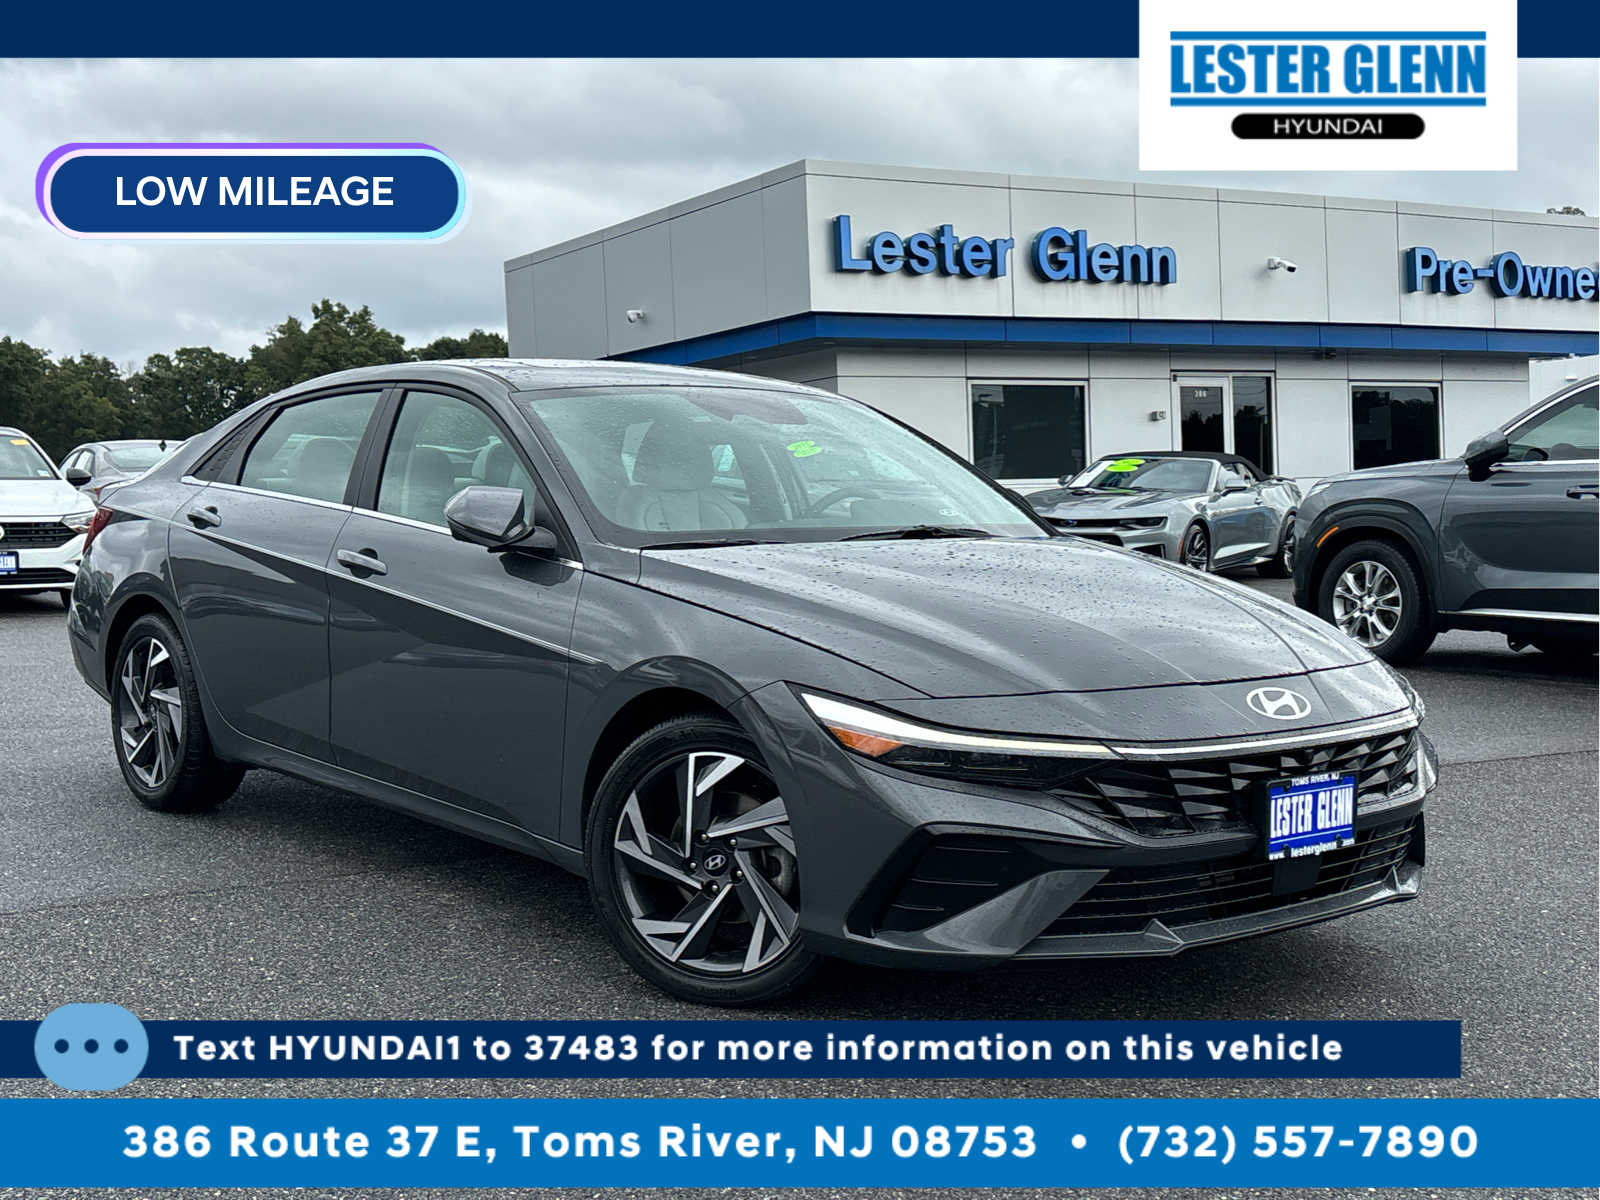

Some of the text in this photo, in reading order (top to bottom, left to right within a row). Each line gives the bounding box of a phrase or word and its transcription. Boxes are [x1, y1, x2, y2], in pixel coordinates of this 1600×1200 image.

[833, 215, 1177, 285] Lester Glenn
[1407, 247, 1599, 300] Pre-Owne
[1270, 787, 1354, 839] LESTER GLENN
